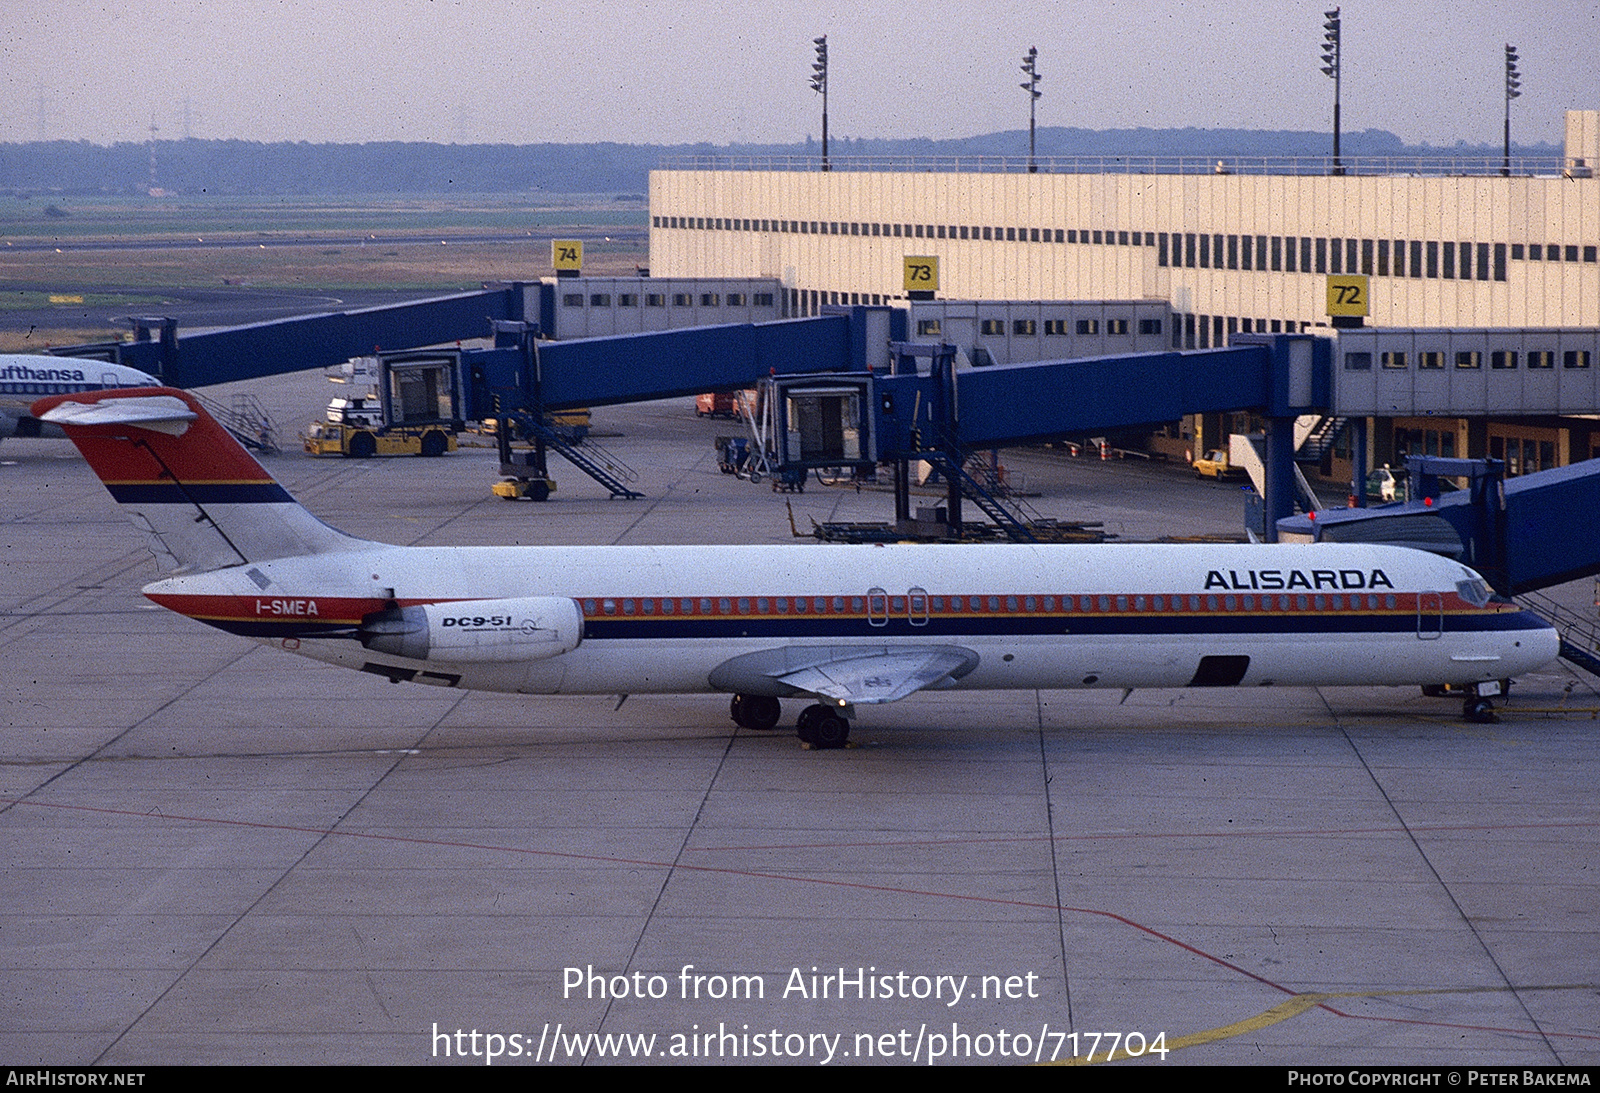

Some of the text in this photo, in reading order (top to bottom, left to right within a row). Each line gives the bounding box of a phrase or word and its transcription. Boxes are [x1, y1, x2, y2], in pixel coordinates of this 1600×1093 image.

[558, 248, 578, 262] 74
[908, 265, 931, 281] 73
[1332, 285, 1361, 304] 72
[1204, 569, 1394, 590] ALISARDA
[256, 599, 318, 615] I-SMEA
[442, 615, 512, 627] DC9-51
